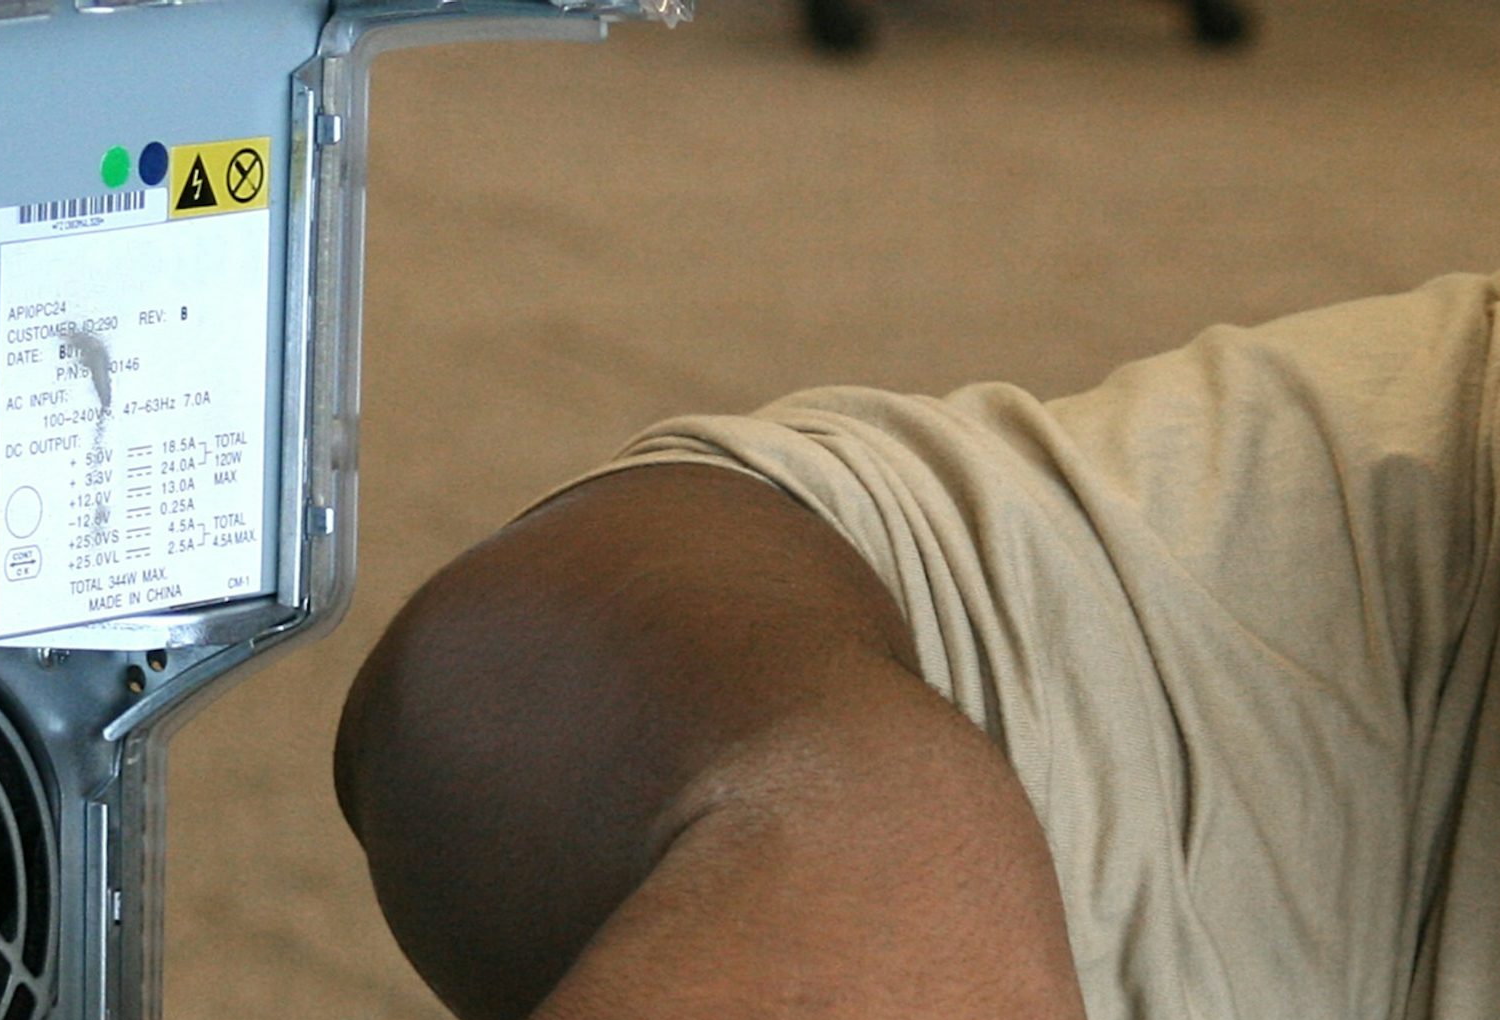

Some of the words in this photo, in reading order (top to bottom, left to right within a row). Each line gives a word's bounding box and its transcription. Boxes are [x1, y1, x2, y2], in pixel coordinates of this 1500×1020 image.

[138, 309, 167, 326] REV:
[7, 322, 77, 344] CUSTOMER
[6, 348, 43, 367] DATE:
[5, 396, 23, 412] AC
[29, 389, 69, 408] INPUT:
[122, 398, 177, 416] 47-63Hz
[183, 391, 212, 408] 7.0A
[5, 443, 23, 459] DC
[29, 434, 82, 456] OUTPUT:
[161, 436, 197, 455] 18.5A
[214, 431, 248, 449] TOTAL
[160, 456, 196, 475] 24.0A
[214, 451, 243, 467] 120W
[213, 470, 238, 486] MAX
[69, 490, 112, 509] +12.0V
[161, 477, 196, 495] 13.0A
[159, 498, 195, 516] 0.25A
[167, 517, 196, 534] 4.5A
[213, 512, 246, 530] TOTAL
[68, 551, 120, 571] +25.0VL
[167, 538, 195, 555] 2.5A
[69, 578, 104, 595] TOTAL
[107, 571, 138, 590] 344W
[88, 595, 123, 612] MADE
[128, 592, 141, 606] IN
[145, 585, 183, 603] CHINA
